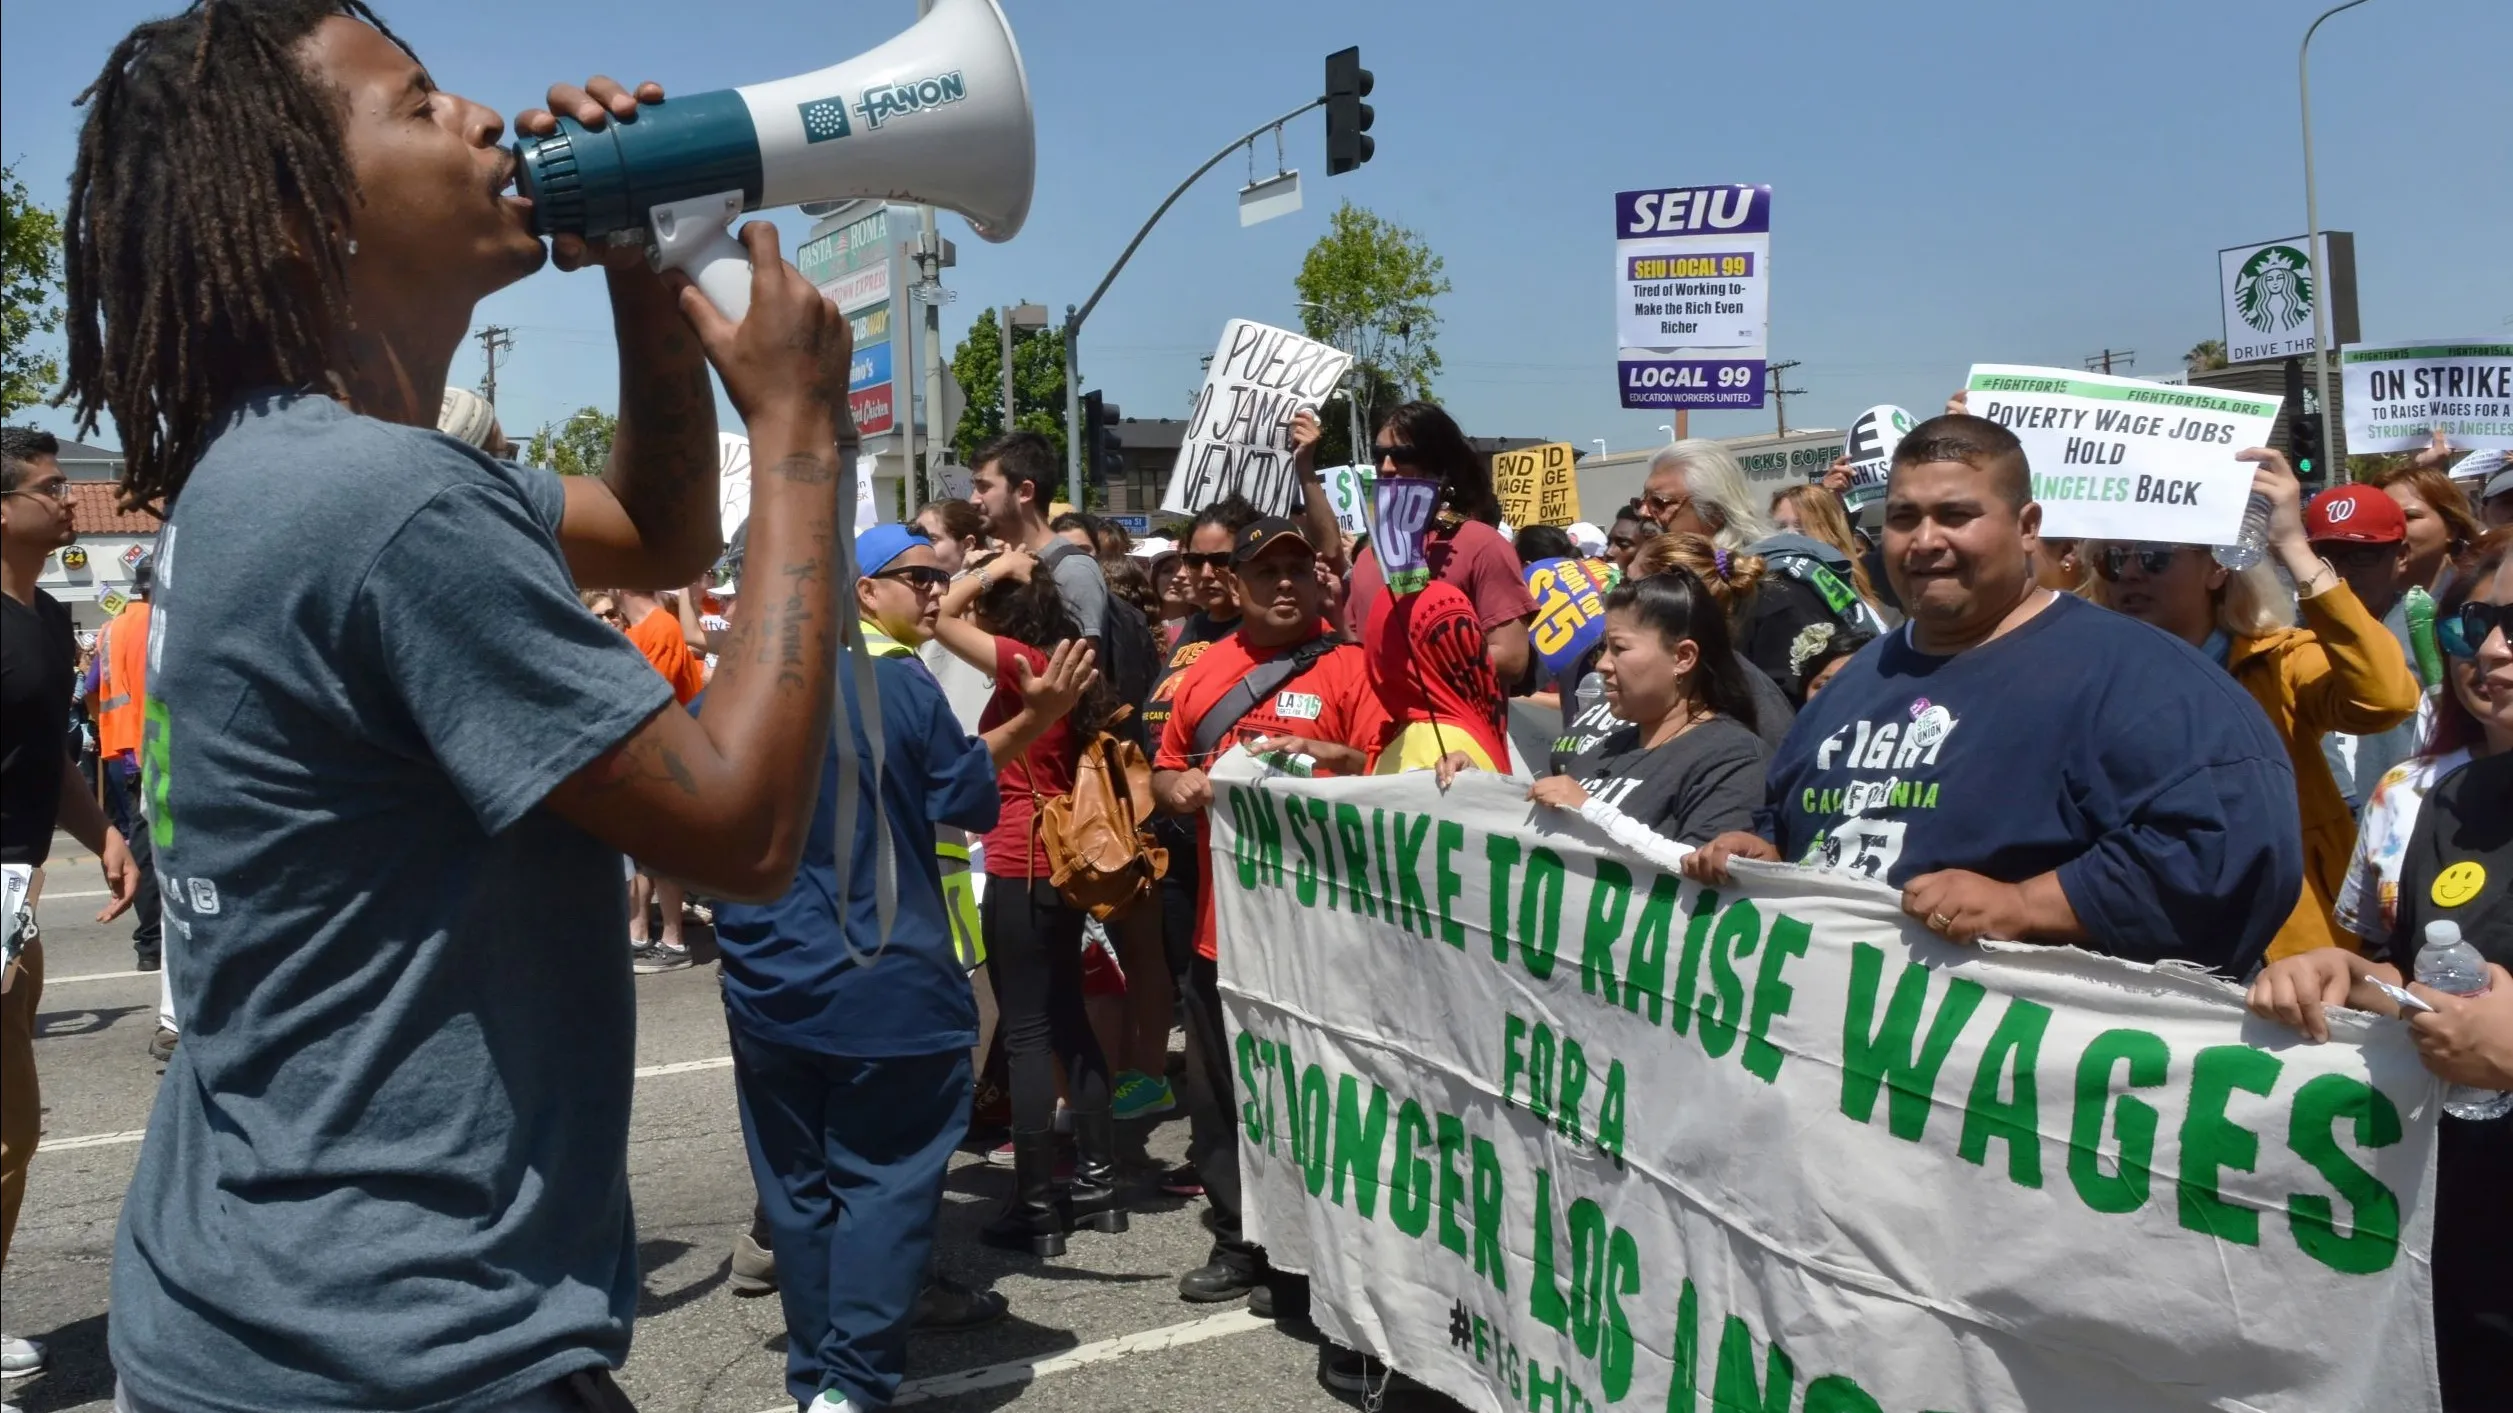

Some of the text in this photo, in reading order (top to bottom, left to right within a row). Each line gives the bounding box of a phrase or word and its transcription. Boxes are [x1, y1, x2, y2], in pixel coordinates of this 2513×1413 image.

[853, 70, 966, 131] FANON
[1630, 189, 1754, 234] SEIU
[799, 213, 887, 272] PASTA ROMA
[1634, 256, 1746, 279] SEIU LOCAL 99
[855, 267, 887, 296] EXPRESS
[1634, 284, 1660, 297] Tired
[1662, 284, 1673, 296] of
[1675, 282, 1726, 297] Working
[1635, 301, 1743, 316] Make the Rich Even
[1661, 321, 1698, 334] Richer
[2234, 334, 2327, 360] DRIVE THR
[849, 358, 874, 383] ino's
[1223, 324, 1348, 398] PUEBLO
[1629, 366, 1751, 388] LOCAL 99
[2370, 367, 2511, 401] ON STRIKE
[1629, 393, 1751, 402] EDUCATION WORKERS UNITED
[1982, 378, 2261, 415] #FIGHTFOR15 FIGHTFOR15LA.ORG
[863, 399, 889, 425] Chicken
[2372, 406, 2387, 420] TO
[2474, 404, 2498, 417] FOR
[2502, 404, 2511, 417] A
[1498, 456, 1534, 477] END
[1736, 452, 1788, 471] UCKS
[1497, 479, 1533, 495] WAGE
[1542, 488, 1569, 504] EFT
[1540, 503, 1566, 518] OW!
[65, 554, 85, 563] 24
[1553, 560, 1591, 596] Fight
[1577, 591, 1605, 619] for
[1277, 692, 1294, 708] LA
[1917, 723, 1942, 742] UNION
[1229, 785, 2402, 1275] ON STRIKE TO RAISE WAGES
[1503, 1011, 1626, 1171] FOR A
[1236, 1030, 1507, 1295] STONGER
[1530, 1168, 1640, 1403] LOS
[1450, 1298, 1594, 1413] #FIGHT
